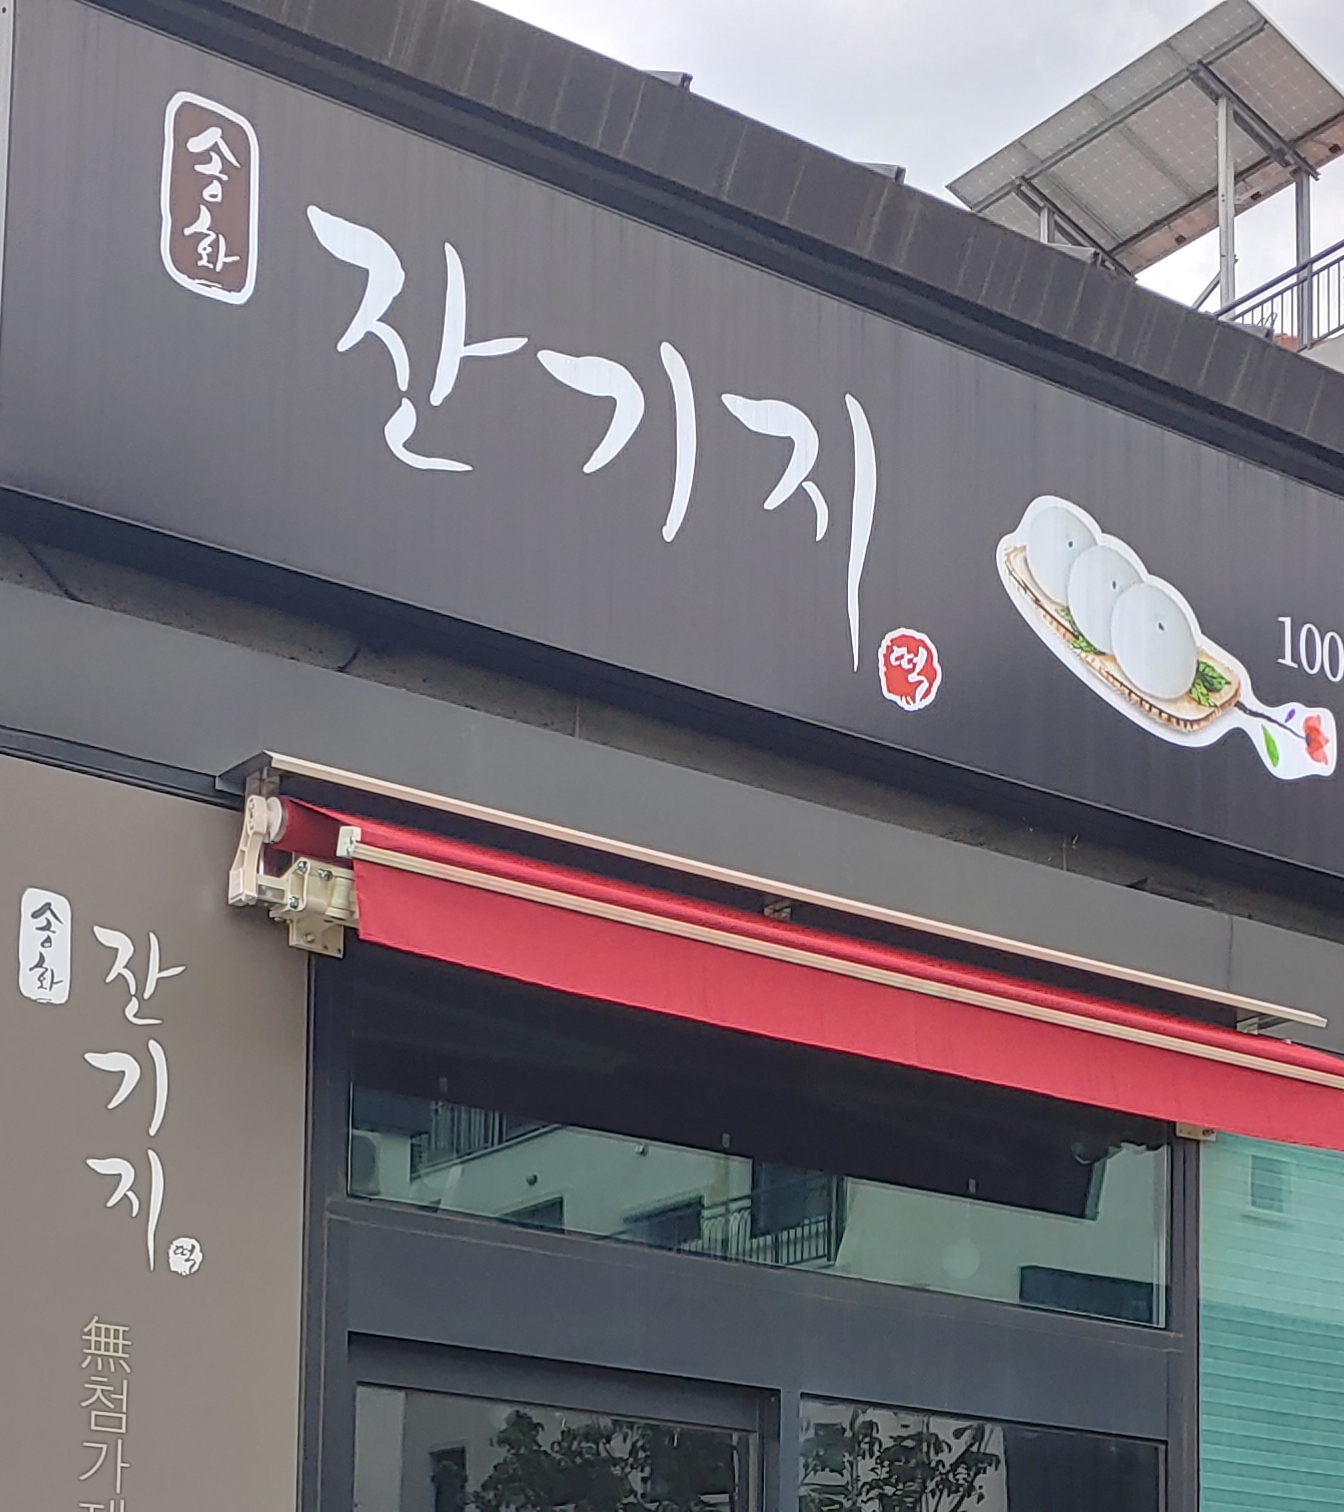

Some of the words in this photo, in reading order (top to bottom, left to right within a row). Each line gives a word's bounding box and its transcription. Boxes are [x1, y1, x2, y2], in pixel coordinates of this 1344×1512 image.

[184, 125, 242, 274] 송화
[307, 205, 877, 671] 잔기지
[28, 901, 64, 993] 송화
[83, 924, 186, 1272] 잔기지
